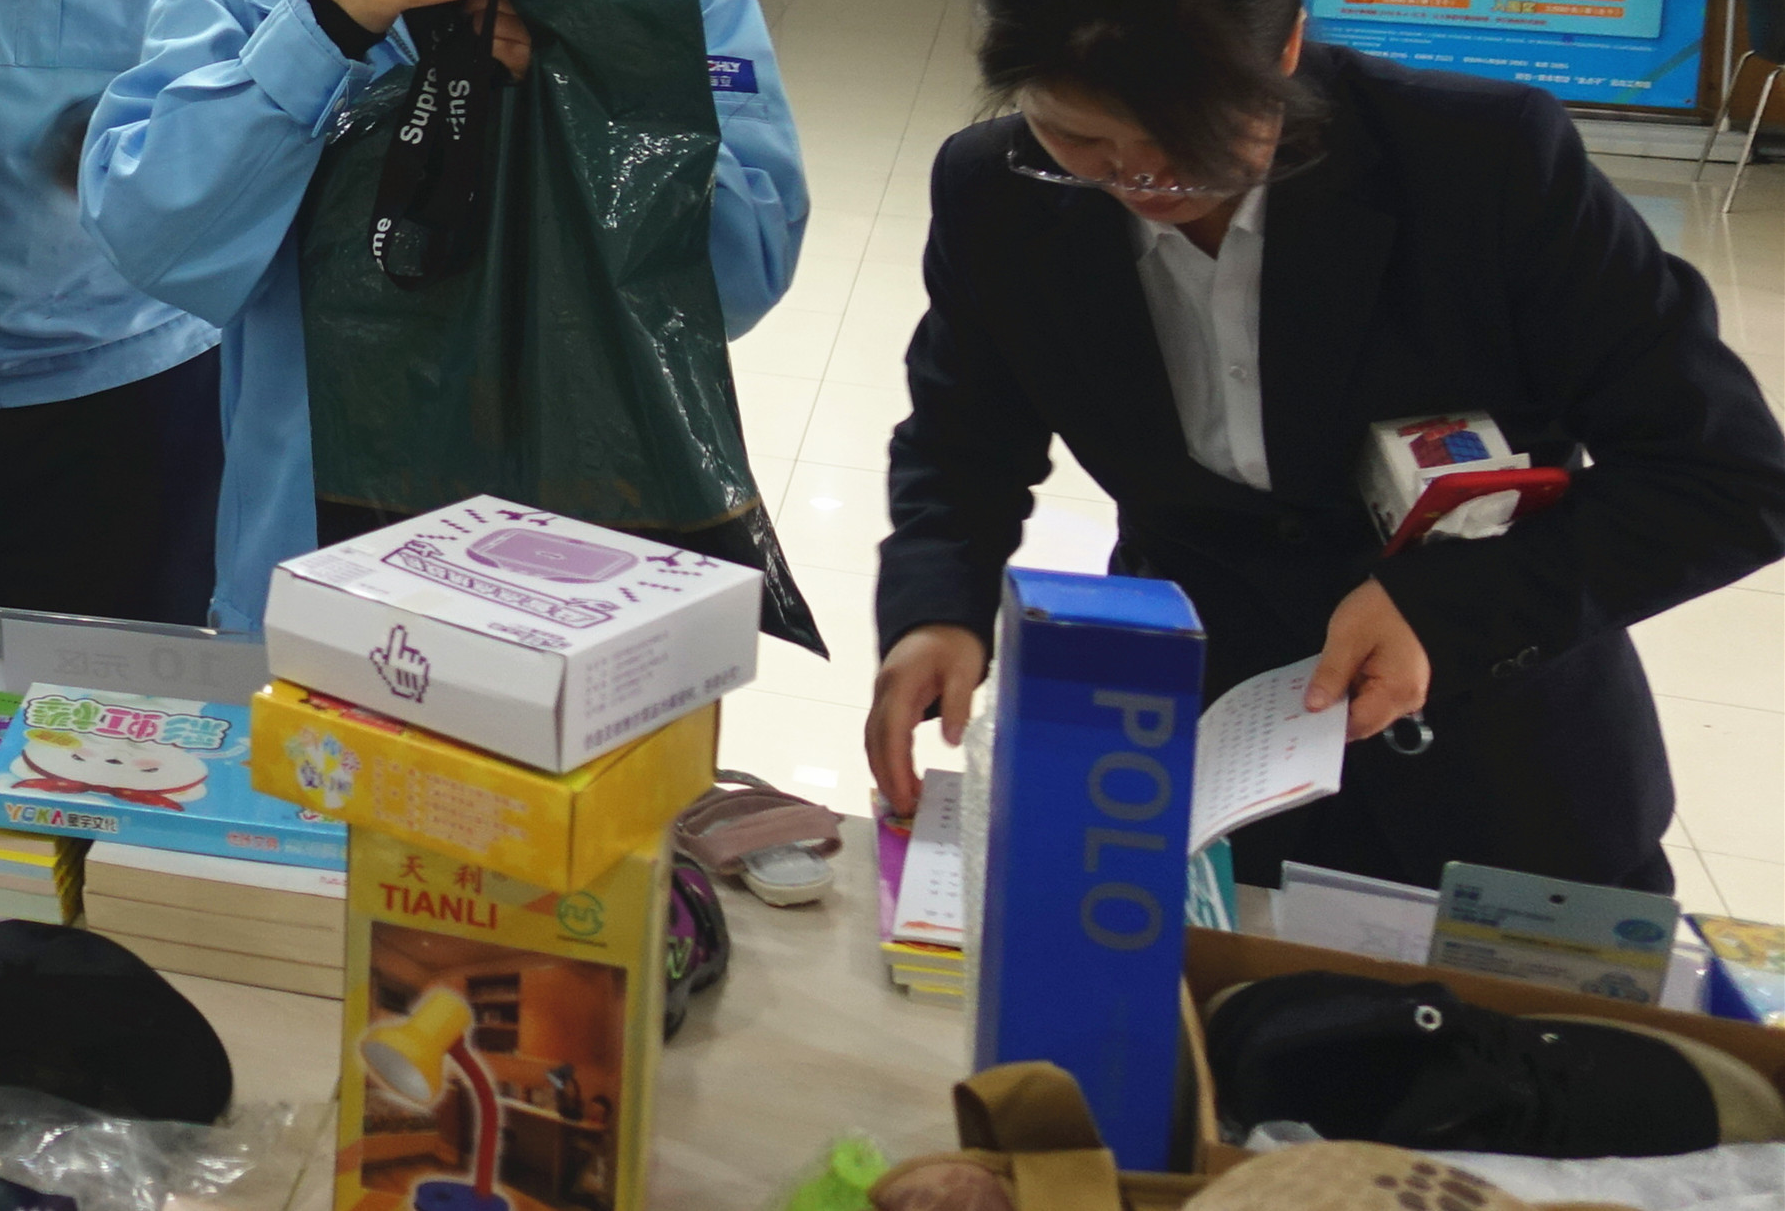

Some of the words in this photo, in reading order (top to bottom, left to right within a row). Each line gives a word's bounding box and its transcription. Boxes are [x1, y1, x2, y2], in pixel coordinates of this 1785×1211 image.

[399, 67, 438, 145] Supre
[1079, 688, 1180, 953] POLO
[378, 883, 499, 930] TIANLI
